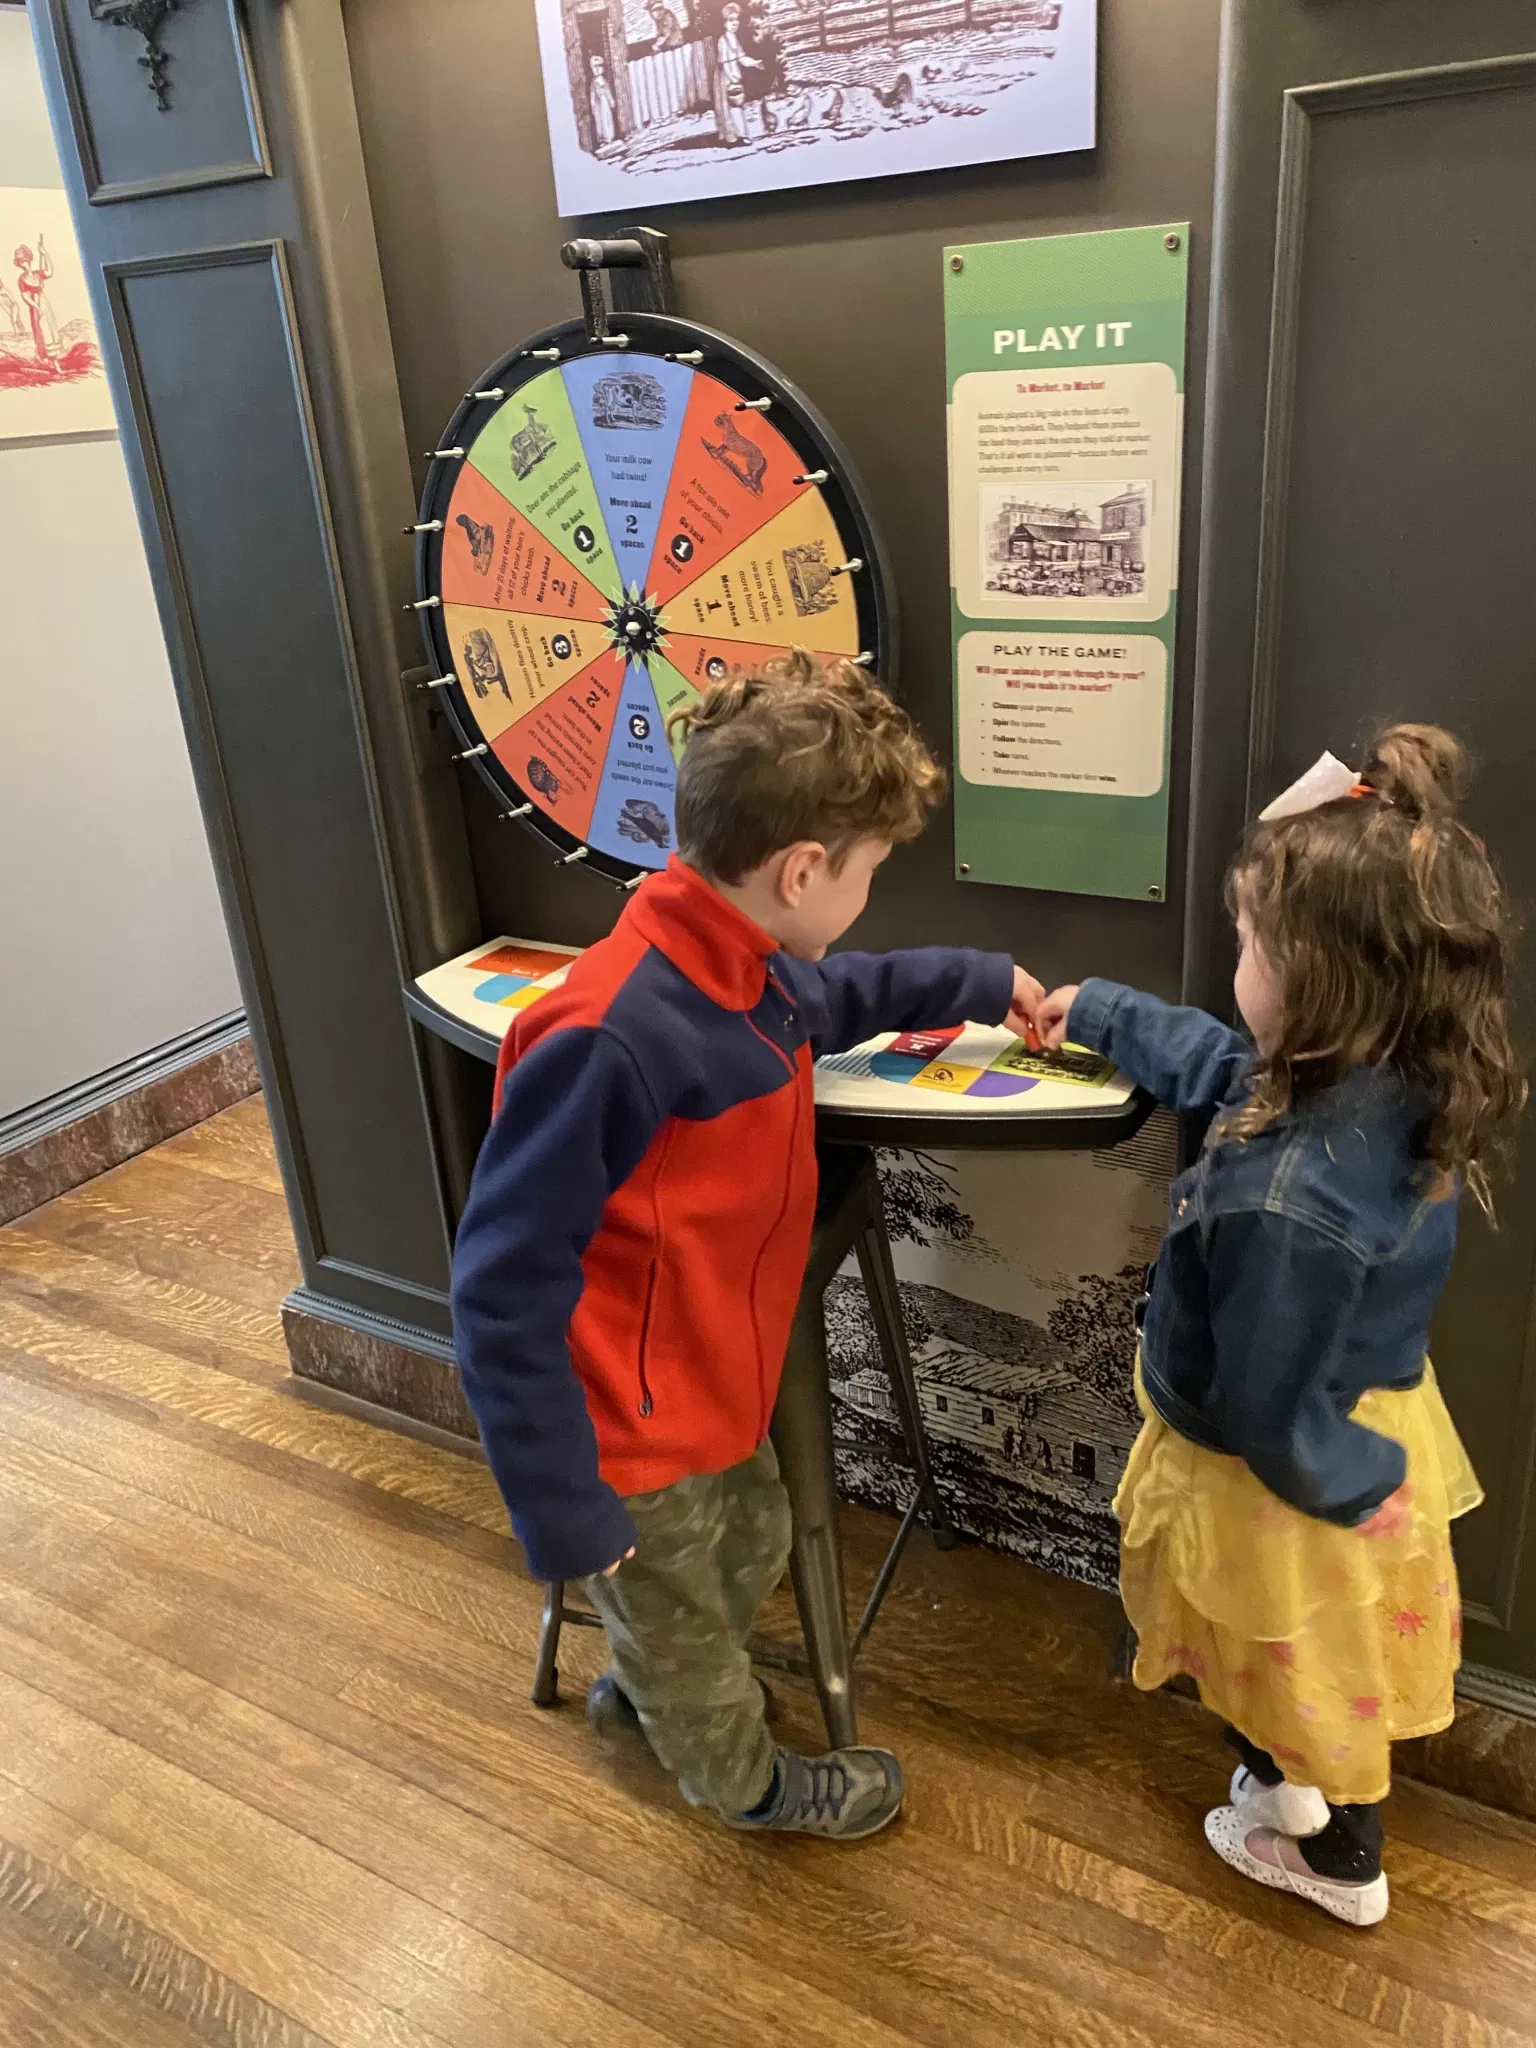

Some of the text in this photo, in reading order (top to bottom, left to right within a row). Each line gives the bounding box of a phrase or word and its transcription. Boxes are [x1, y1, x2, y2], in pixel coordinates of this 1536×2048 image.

[993, 321, 1132, 355] PLAY IT
[605, 452, 652, 465] Your milk cow
[611, 471, 647, 482] had twins!
[690, 478, 697, 486] A
[548, 482, 559, 493] the
[609, 497, 652, 509] Move ahead
[686, 498, 703, 512] your
[569, 509, 585, 524] back
[626, 515, 638, 534] 2
[679, 516, 705, 544] Go back
[579, 531, 591, 547] 1
[620, 539, 645, 549] spaces
[503, 545, 509, 555] of
[676, 542, 688, 557] 1
[499, 556, 508, 574] days
[663, 554, 683, 574] space
[497, 574, 504, 583] 21
[511, 570, 517, 580] of
[521, 571, 530, 596] chicks
[536, 556, 551, 603] Move ahead
[751, 561, 762, 589] swarm
[758, 591, 767, 600] of
[765, 559, 773, 576] You
[769, 578, 783, 608] caught
[509, 579, 516, 589] 12
[552, 579, 566, 596] 2
[494, 585, 502, 603] After
[568, 581, 578, 608] spaces
[721, 574, 740, 627] Move ahead
[739, 570, 759, 622] more honey!
[693, 598, 705, 623] space
[706, 600, 722, 614] 1
[507, 620, 520, 648] destroy
[555, 641, 567, 653] 3
[570, 629, 582, 657] spaces
[527, 646, 538, 669] wheat
[540, 636, 554, 668] Go back
[993, 645, 1127, 659] PLAY THE GAME!
[695, 648, 706, 675] spaces
[710, 663, 722, 677] 3
[535, 671, 545, 688] your
[590, 676, 610, 698] spaces
[586, 690, 600, 708] 2
[627, 703, 650, 712] spaces
[567, 696, 602, 732] Move ahead
[634, 719, 644, 735] 2
[627, 741, 653, 753] Go back
[565, 767, 575, 777] cat
